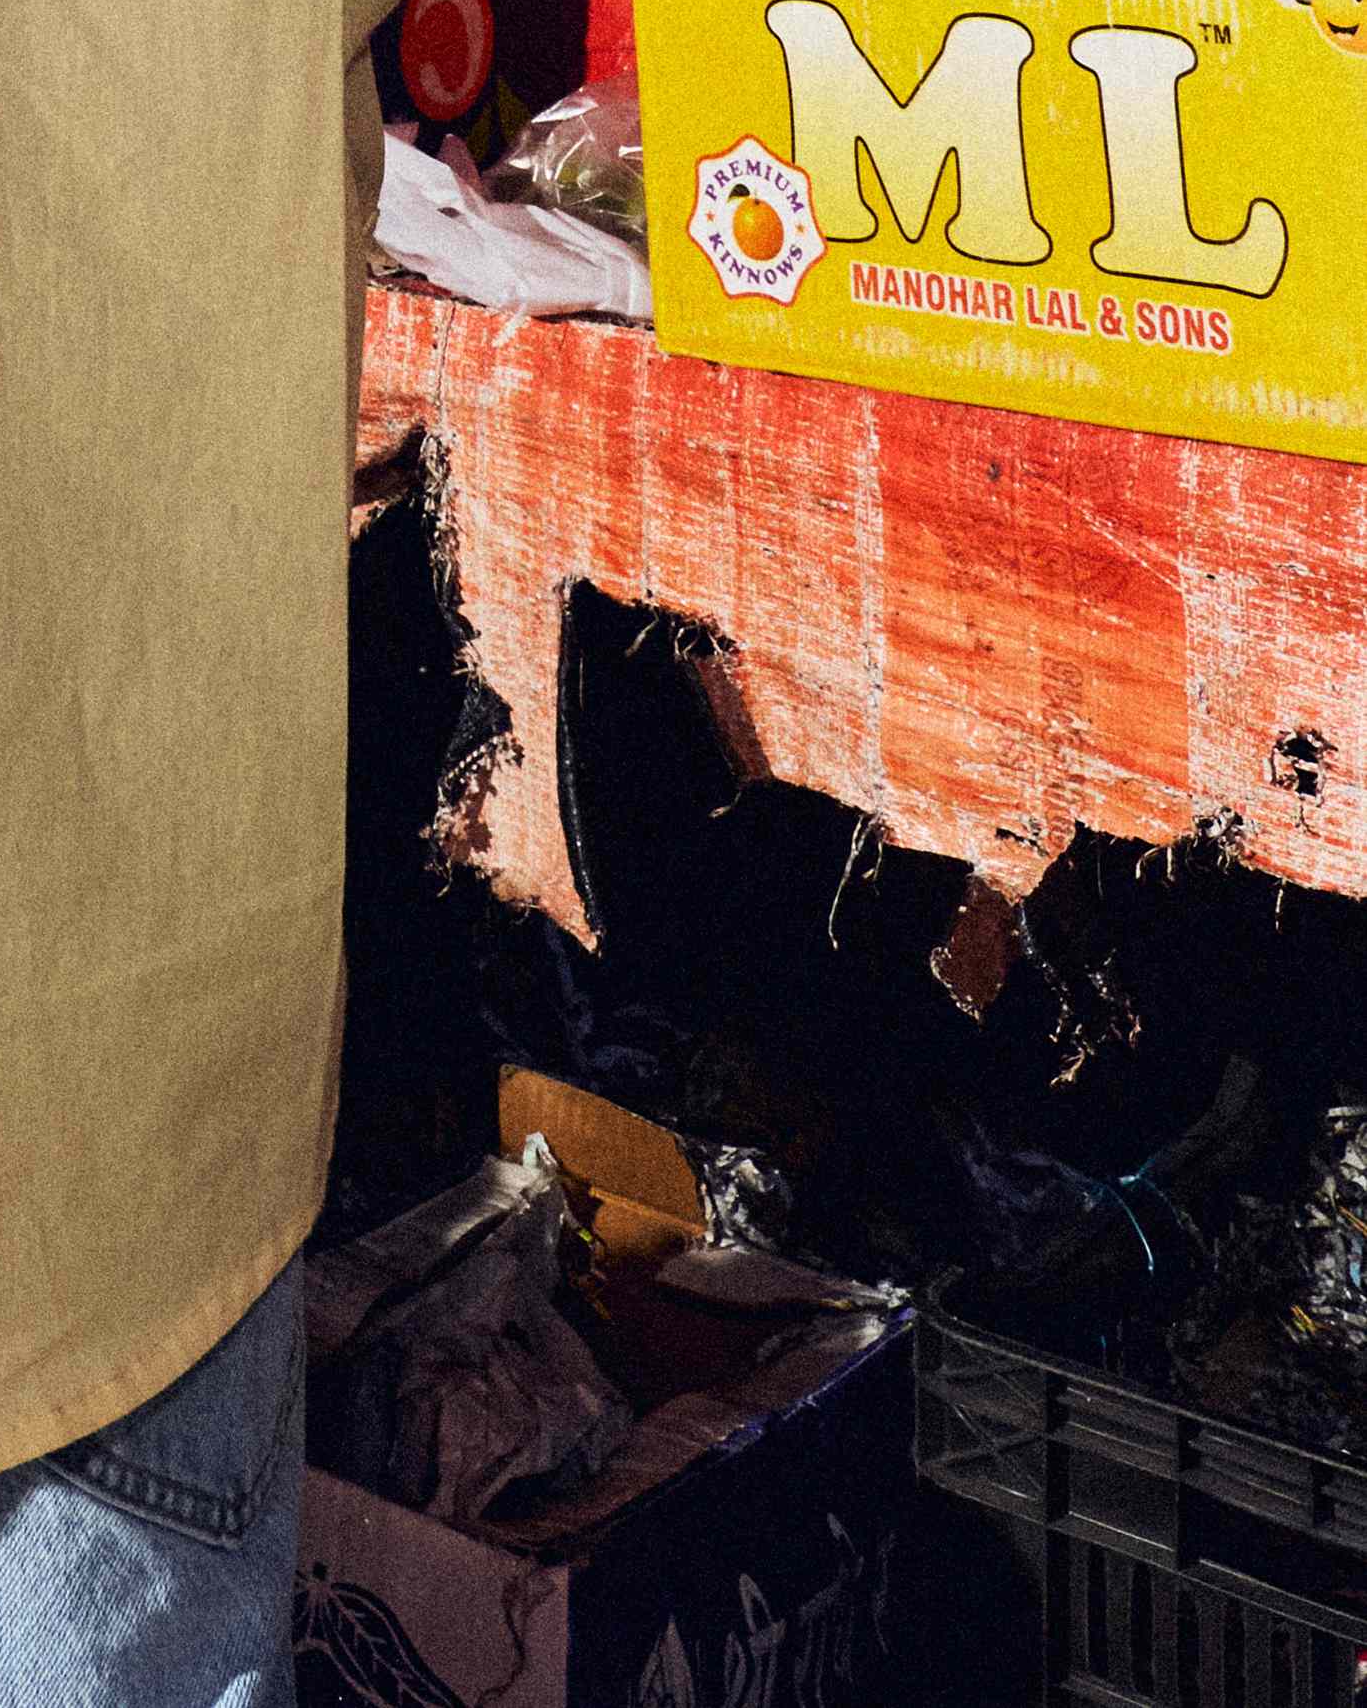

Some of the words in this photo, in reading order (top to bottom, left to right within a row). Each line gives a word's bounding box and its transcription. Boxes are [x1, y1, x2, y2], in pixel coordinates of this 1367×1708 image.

[704, 158, 806, 214] PREMIUM
[706, 230, 805, 285] KINNOWS
[851, 262, 1014, 321] MANOHAR
[1027, 288, 1087, 332] LAL
[1098, 296, 1122, 336] &
[1136, 302, 1231, 351] SONS
